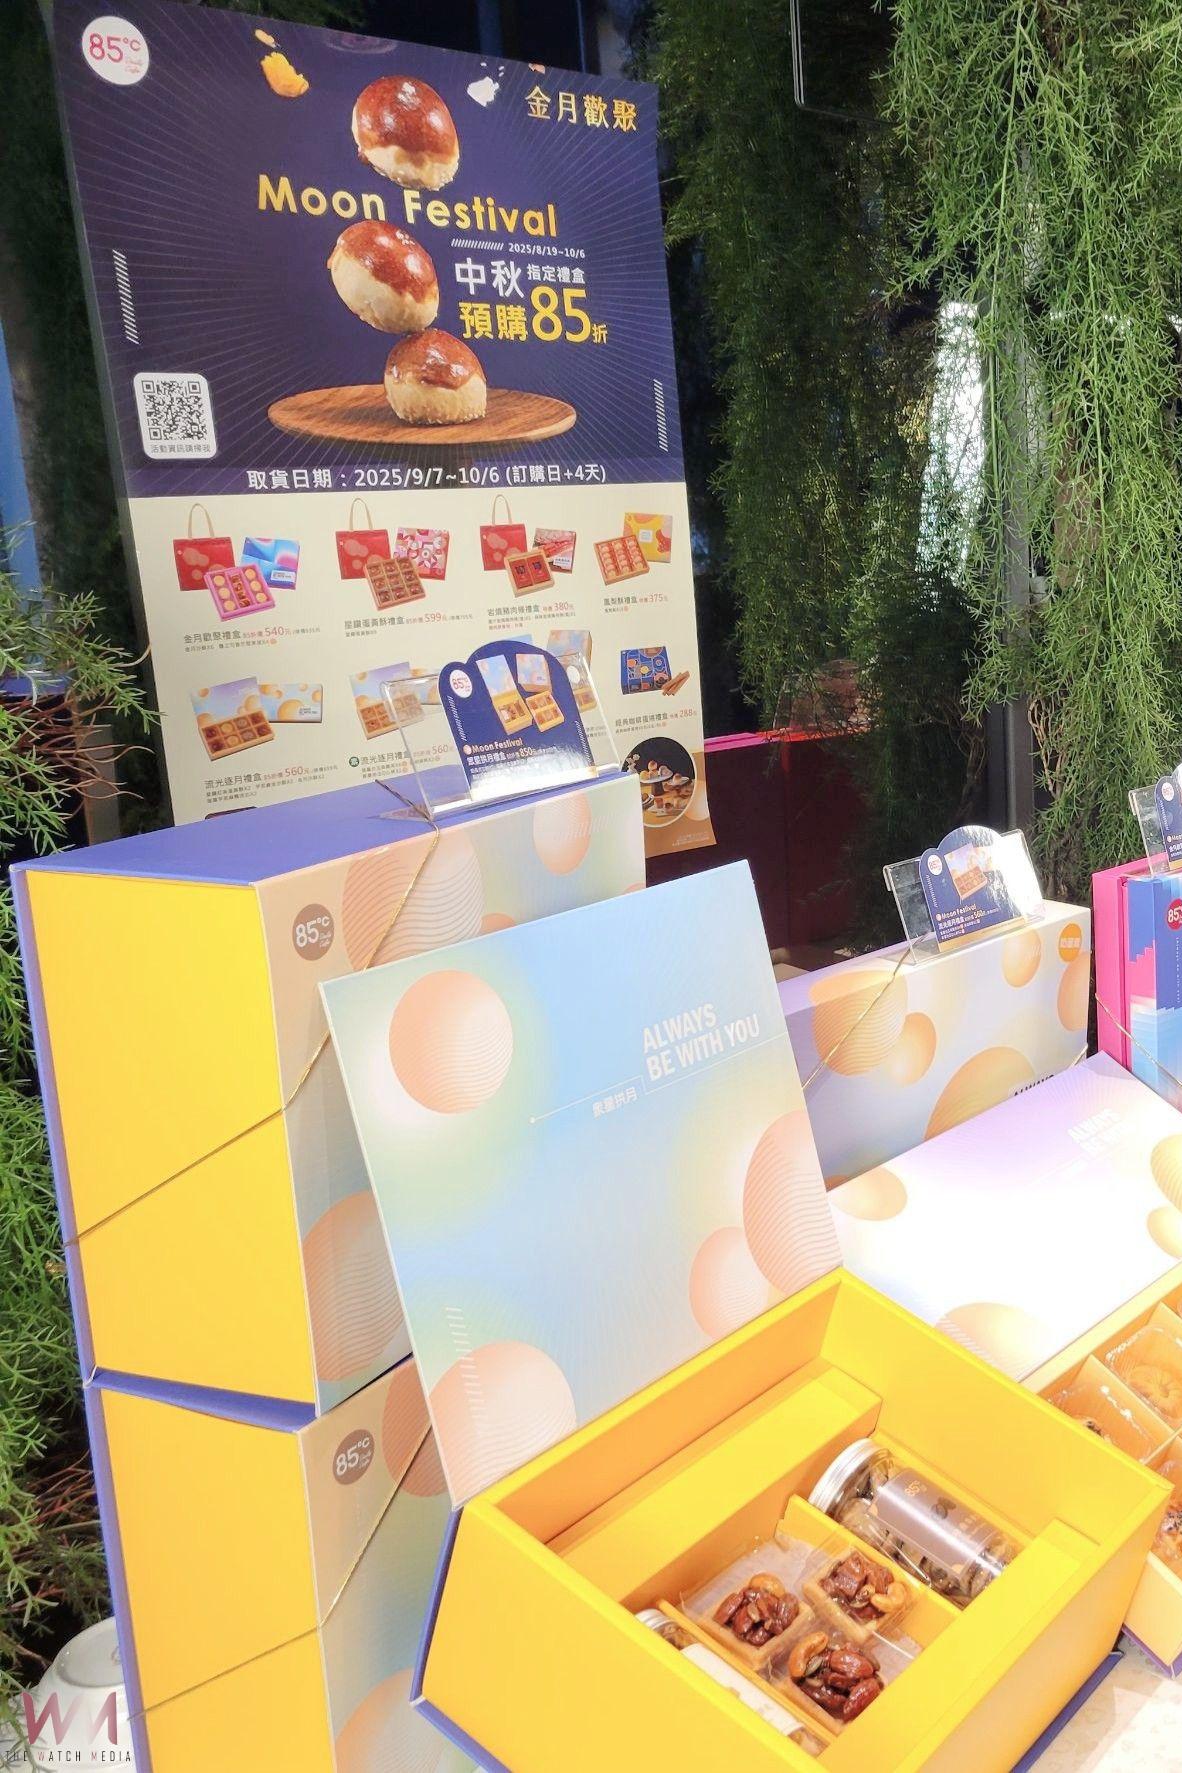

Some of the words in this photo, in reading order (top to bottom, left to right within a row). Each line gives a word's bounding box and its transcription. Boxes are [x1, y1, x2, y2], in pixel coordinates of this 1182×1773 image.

[525, 85, 638, 133] 金月歡聚
[257, 174, 387, 221] Moon
[404, 188, 558, 238] Festival
[455, 257, 525, 299] 中秋
[526, 263, 586, 285] 指定禮盒
[505, 464, 607, 487] (訂購日+4天)
[296, 916, 330, 948] 85°C
[643, 1003, 717, 1054] ALWAYS
[646, 1050, 676, 1082] BE
[675, 1028, 724, 1068] WITH
[724, 1013, 760, 1047] YOU
[336, 1436, 370, 1477] 85°C
